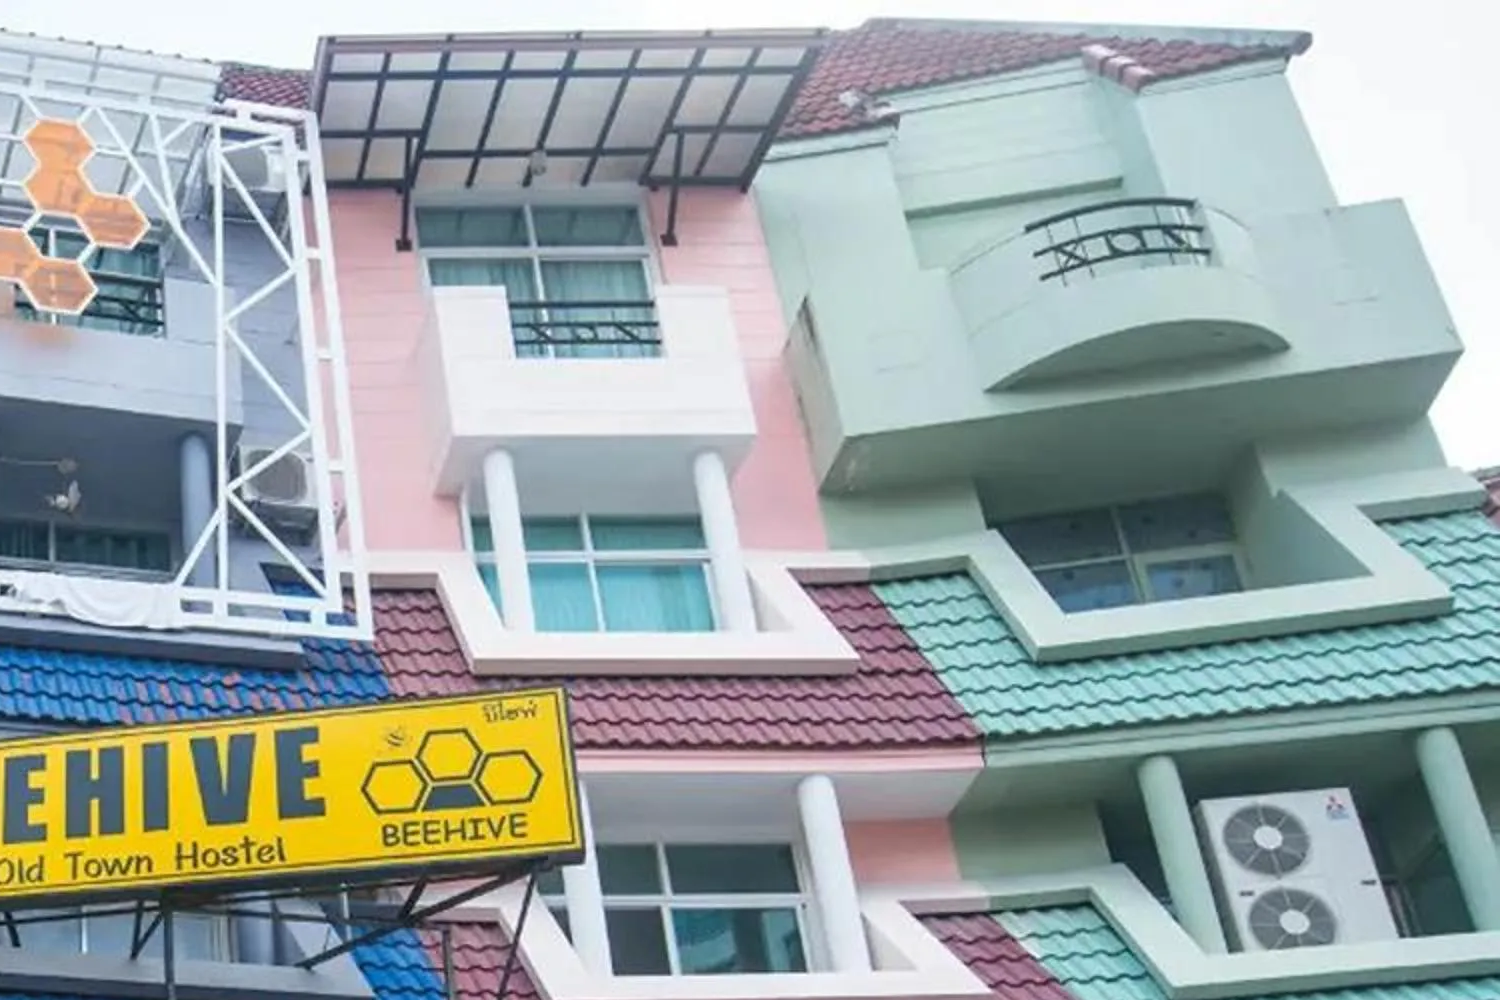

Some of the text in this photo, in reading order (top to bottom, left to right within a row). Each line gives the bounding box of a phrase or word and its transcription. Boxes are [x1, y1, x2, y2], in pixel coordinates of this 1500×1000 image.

[381, 813, 528, 847] BEEHIVE
[63, 850, 154, 881] Town
[175, 836, 287, 870] Hostel
